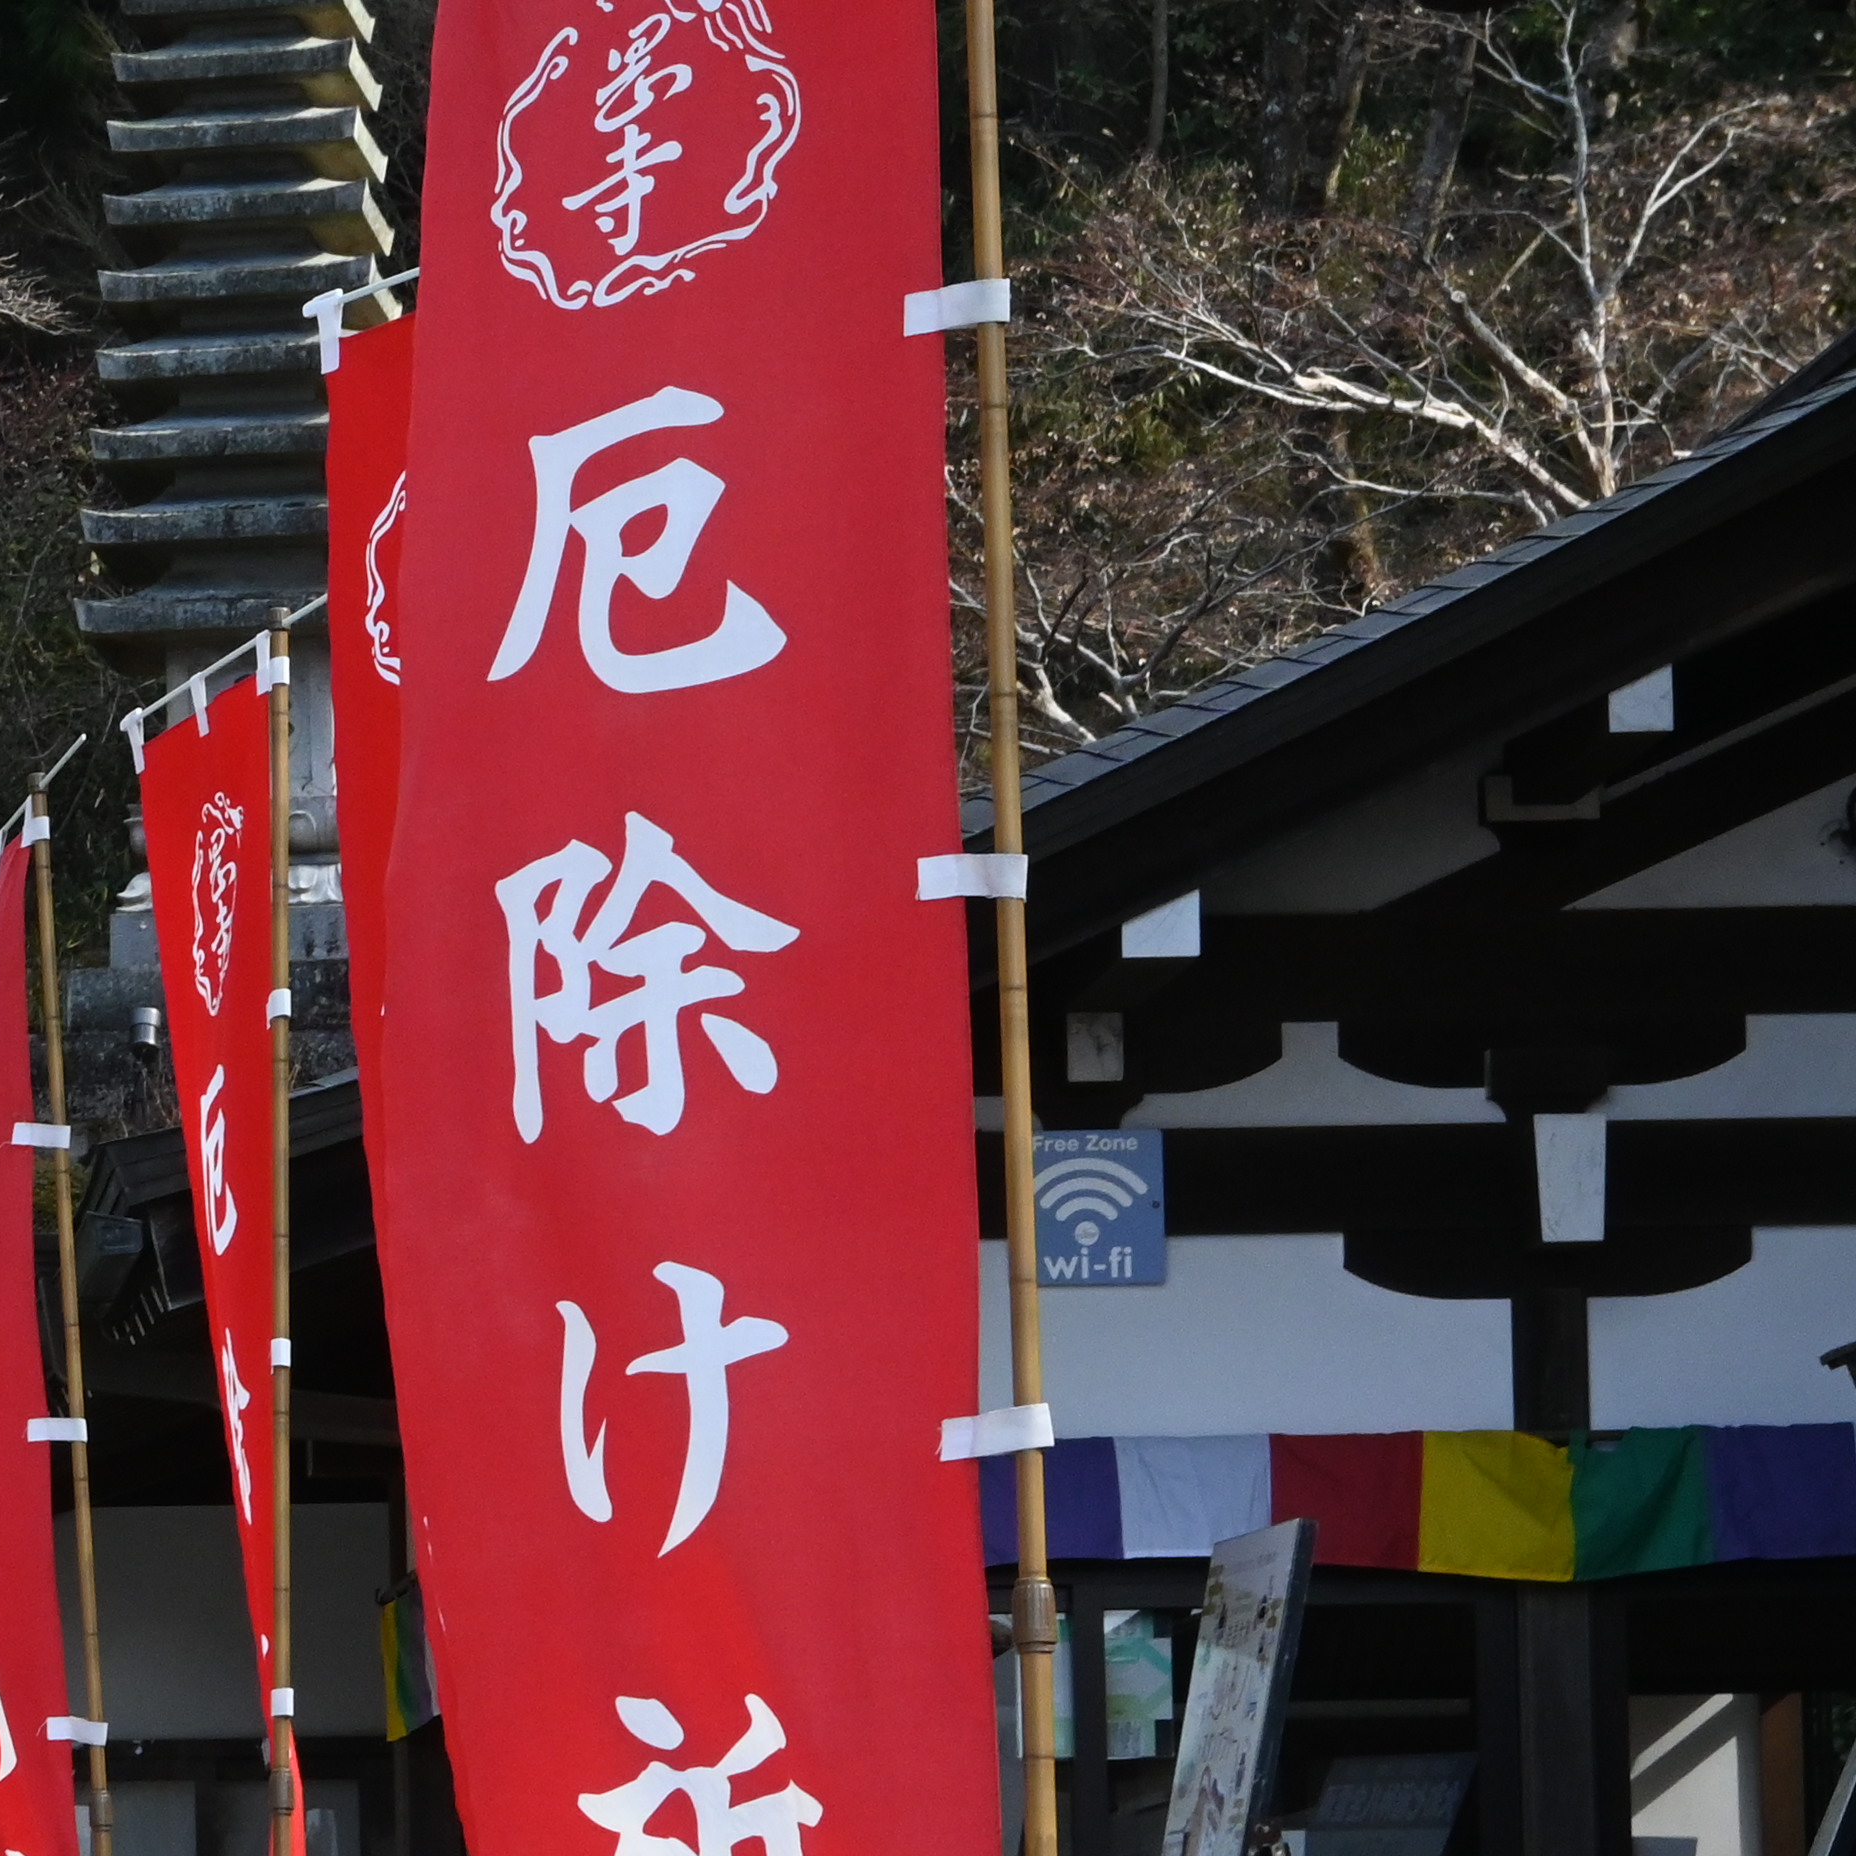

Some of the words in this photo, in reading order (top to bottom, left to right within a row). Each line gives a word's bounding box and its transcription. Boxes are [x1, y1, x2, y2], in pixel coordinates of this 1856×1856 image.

[1033, 1135, 1079, 1152] Free
[1085, 1134, 1138, 1151] Zone
[1043, 1246, 1133, 1280] wi-fi
